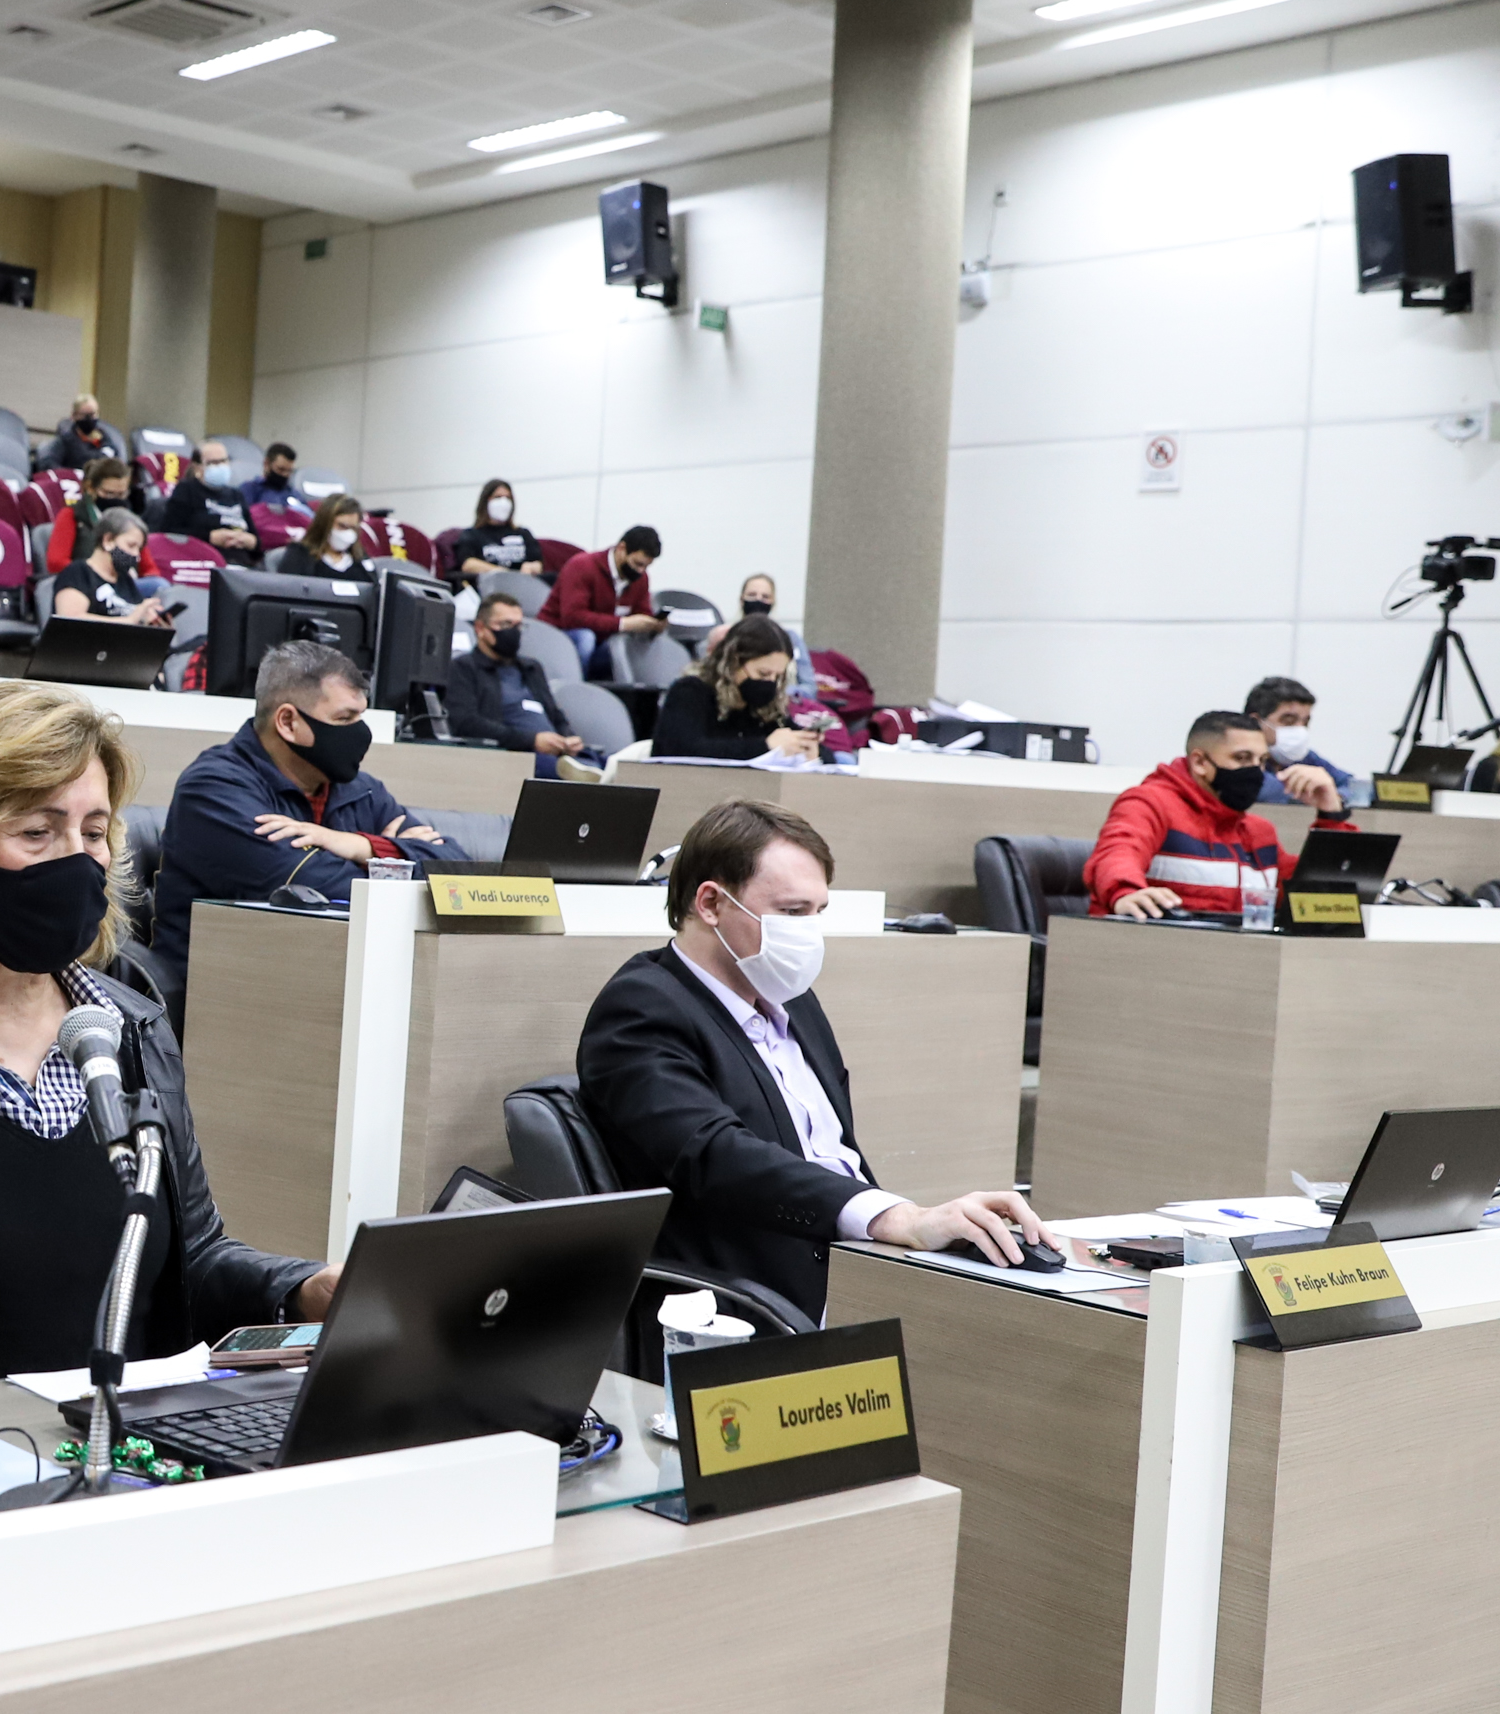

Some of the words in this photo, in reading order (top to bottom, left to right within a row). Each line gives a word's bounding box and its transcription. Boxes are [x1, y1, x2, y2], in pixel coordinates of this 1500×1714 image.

[468, 889, 498, 903] Vladi
[500, 891, 550, 906] Lourenço
[1294, 1274, 1328, 1293] Felipe
[1327, 1270, 1357, 1288] Kuhn
[1355, 1267, 1390, 1283] Braun
[778, 1397, 843, 1429] Lourdes
[845, 1388, 891, 1416] Valim
